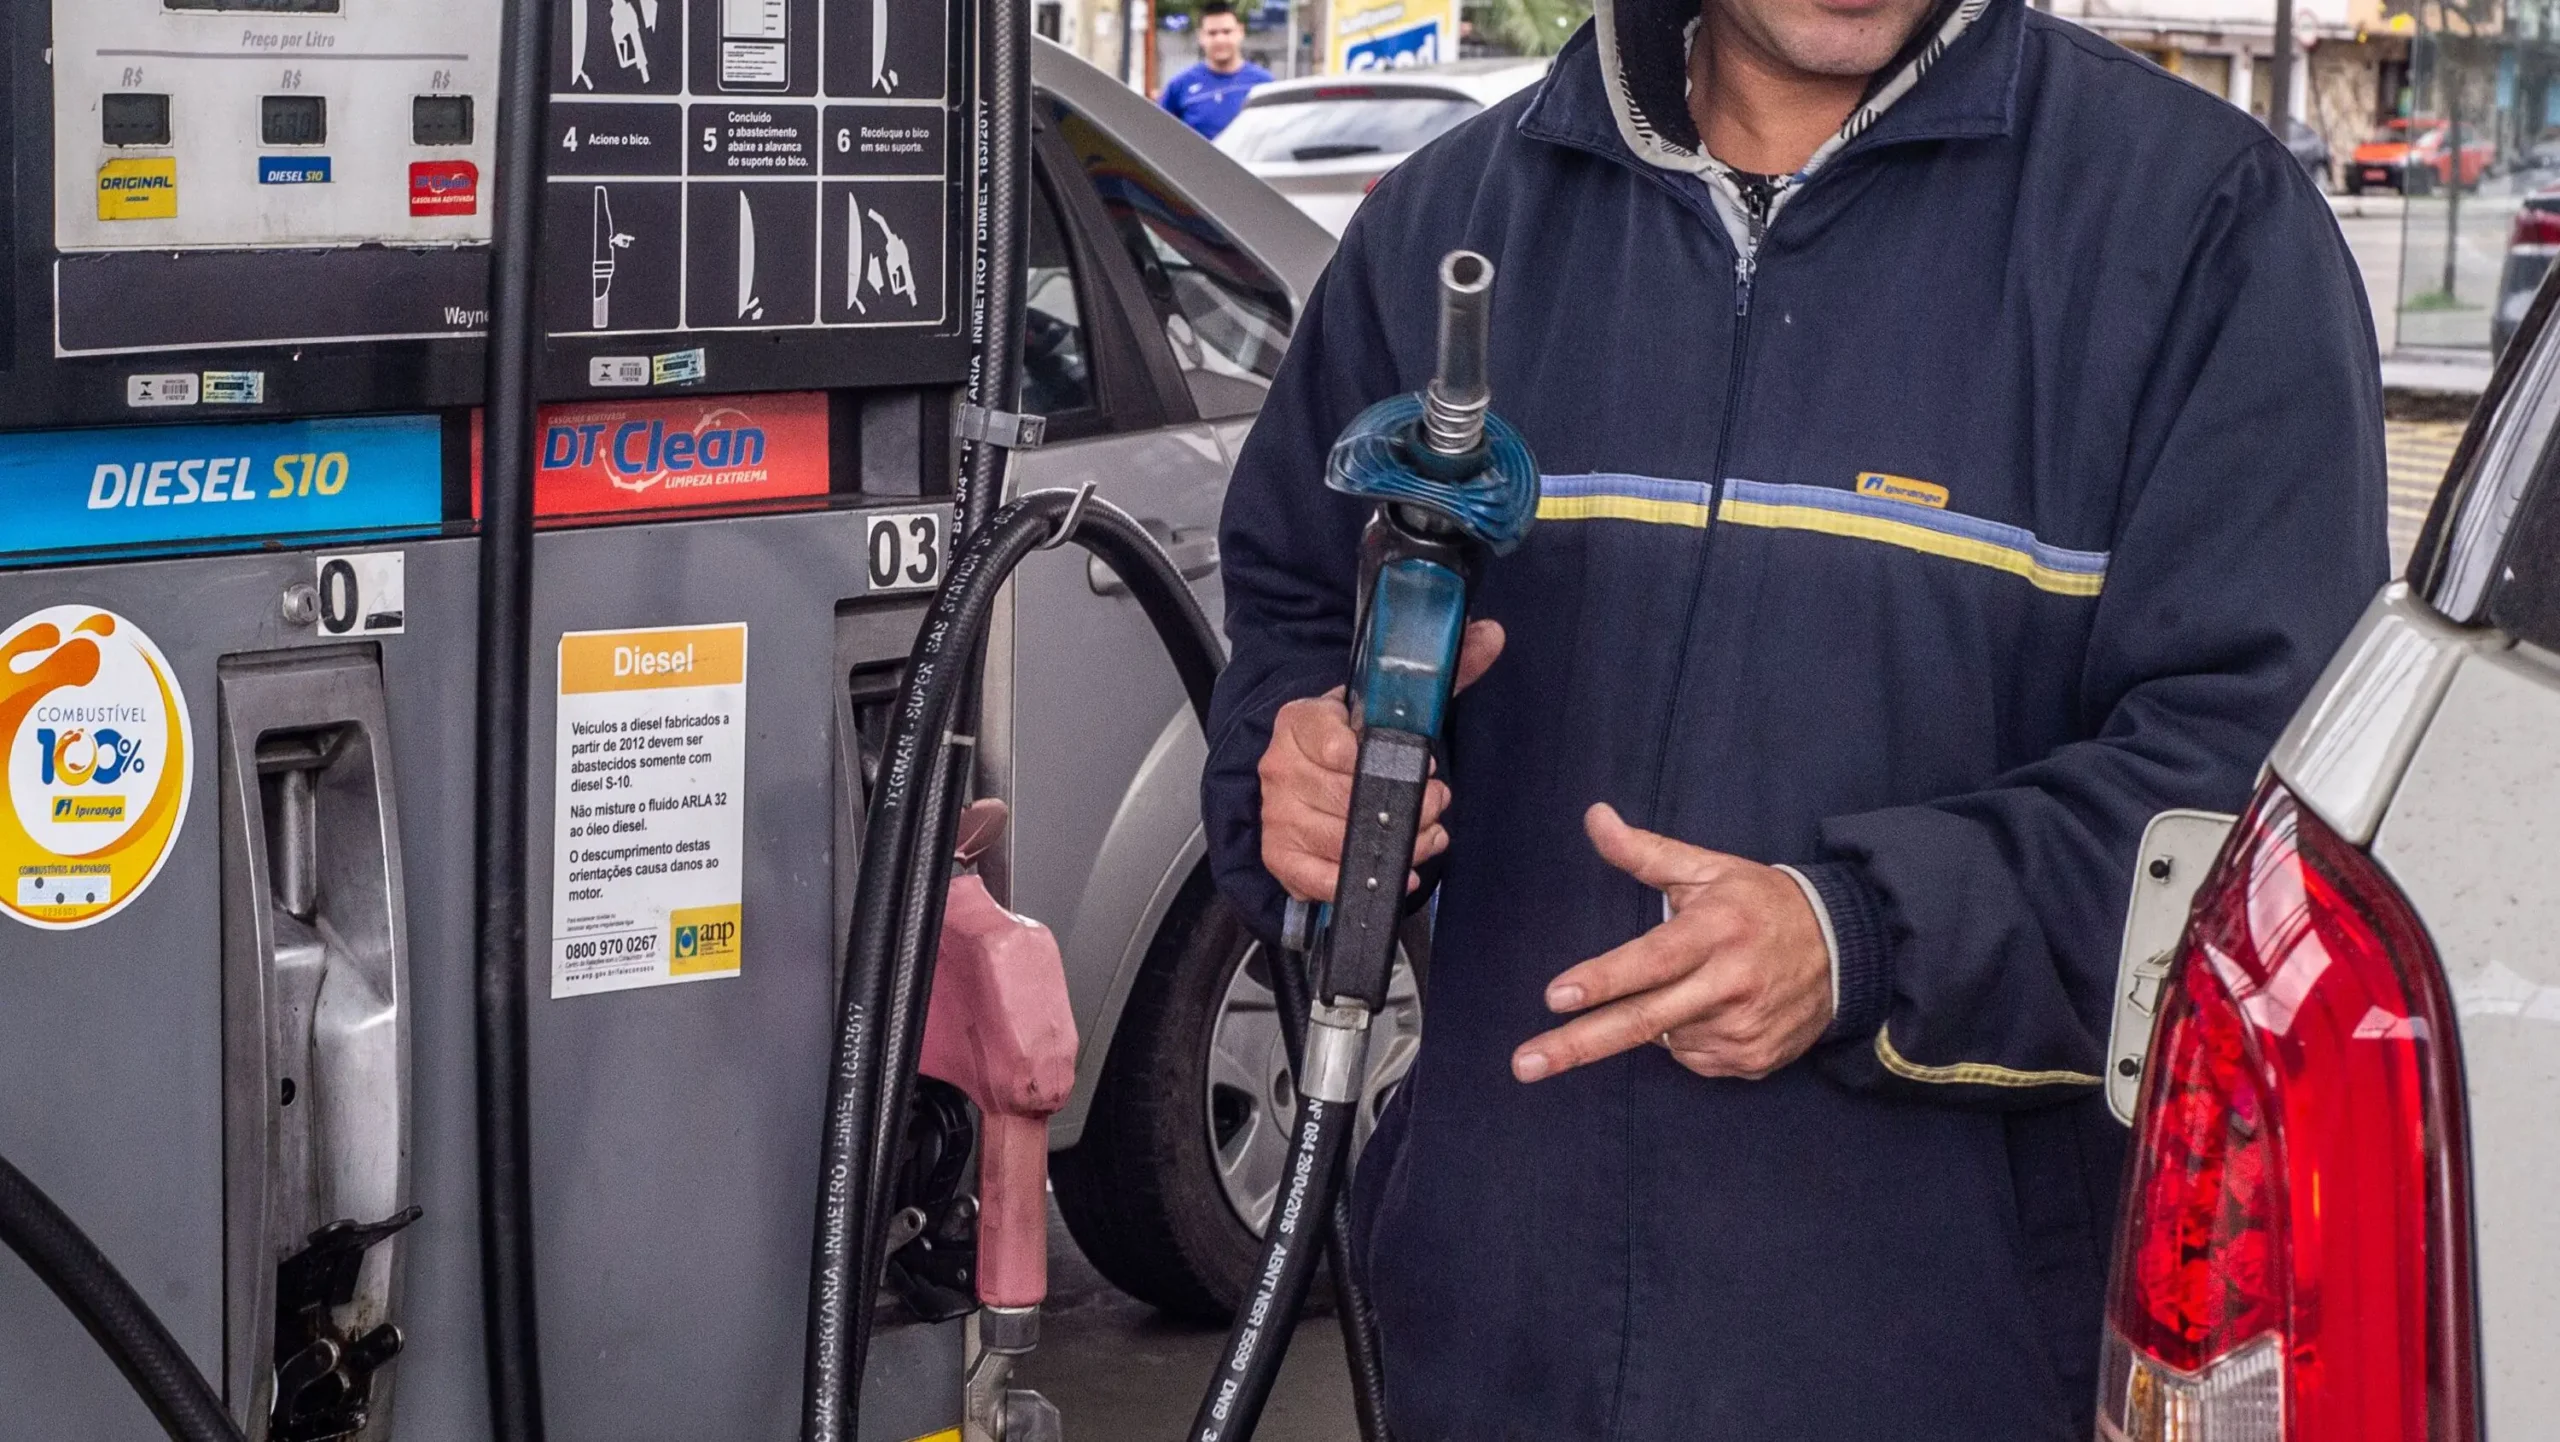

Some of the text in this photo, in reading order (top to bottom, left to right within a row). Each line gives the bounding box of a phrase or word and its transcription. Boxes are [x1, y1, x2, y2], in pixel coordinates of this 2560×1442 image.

[242, 31, 335, 50] Preço por Litro
[122, 66, 143, 87] R$
[282, 69, 302, 89] R$
[432, 70, 451, 89] R$
[728, 111, 772, 123] Concluído
[563, 126, 578, 152] 4
[589, 134, 652, 145] Acione o bico.
[703, 127, 717, 152] 5
[728, 126, 797, 138] o abastecimento
[837, 128, 851, 153] 6
[861, 127, 929, 140] Recoloque o bico
[728, 141, 756, 152] abaixe
[757, 143, 763, 152] a
[861, 144, 873, 152] em
[874, 144, 890, 152] seu
[728, 156, 809, 169] do suporte do bico.
[100, 176, 173, 190] ORIGINAL
[268, 171, 303, 182] DIESEL
[978, 182, 988, 241] DIMEL
[972, 259, 987, 344] INMETRO
[542, 419, 766, 476] DT Clean
[87, 452, 349, 510] DIESEL S10
[665, 470, 768, 489] LIMPEZA EXTREMA
[869, 516, 938, 587] 03
[613, 643, 694, 676] Diesel
[906, 661, 935, 720] SUPER
[925, 620, 949, 654] GAS
[37, 704, 146, 722] COMBUSTÍVEL
[572, 713, 729, 736] Veículos a diesel fabricados a
[37, 728, 145, 786] 100%
[572, 735, 704, 757] partir de 2012 devem ser
[571, 752, 712, 774] abastecidos somente com
[571, 775, 633, 793] diesel S-10.
[75, 805, 122, 818] Ipiranga
[571, 805, 592, 819] Não
[595, 802, 636, 816] misture
[638, 802, 646, 812] o
[681, 795, 712, 809] ARLA
[714, 792, 727, 805] 32
[570, 818, 647, 837] ao óleo diesel.
[569, 839, 710, 863] O descumprimento destas
[70, 864, 111, 874] APROVADOS
[569, 857, 719, 882] orientações causa danos ao
[569, 887, 603, 901] motor.
[700, 921, 735, 947] anp
[566, 935, 657, 960] 0800 970 0267
[1302, 1122, 1320, 1152] 084
[824, 1164, 848, 1255] INMETRO
[1262, 1242, 1288, 1292] ABNT
[1247, 1289, 1273, 1327] NBR
